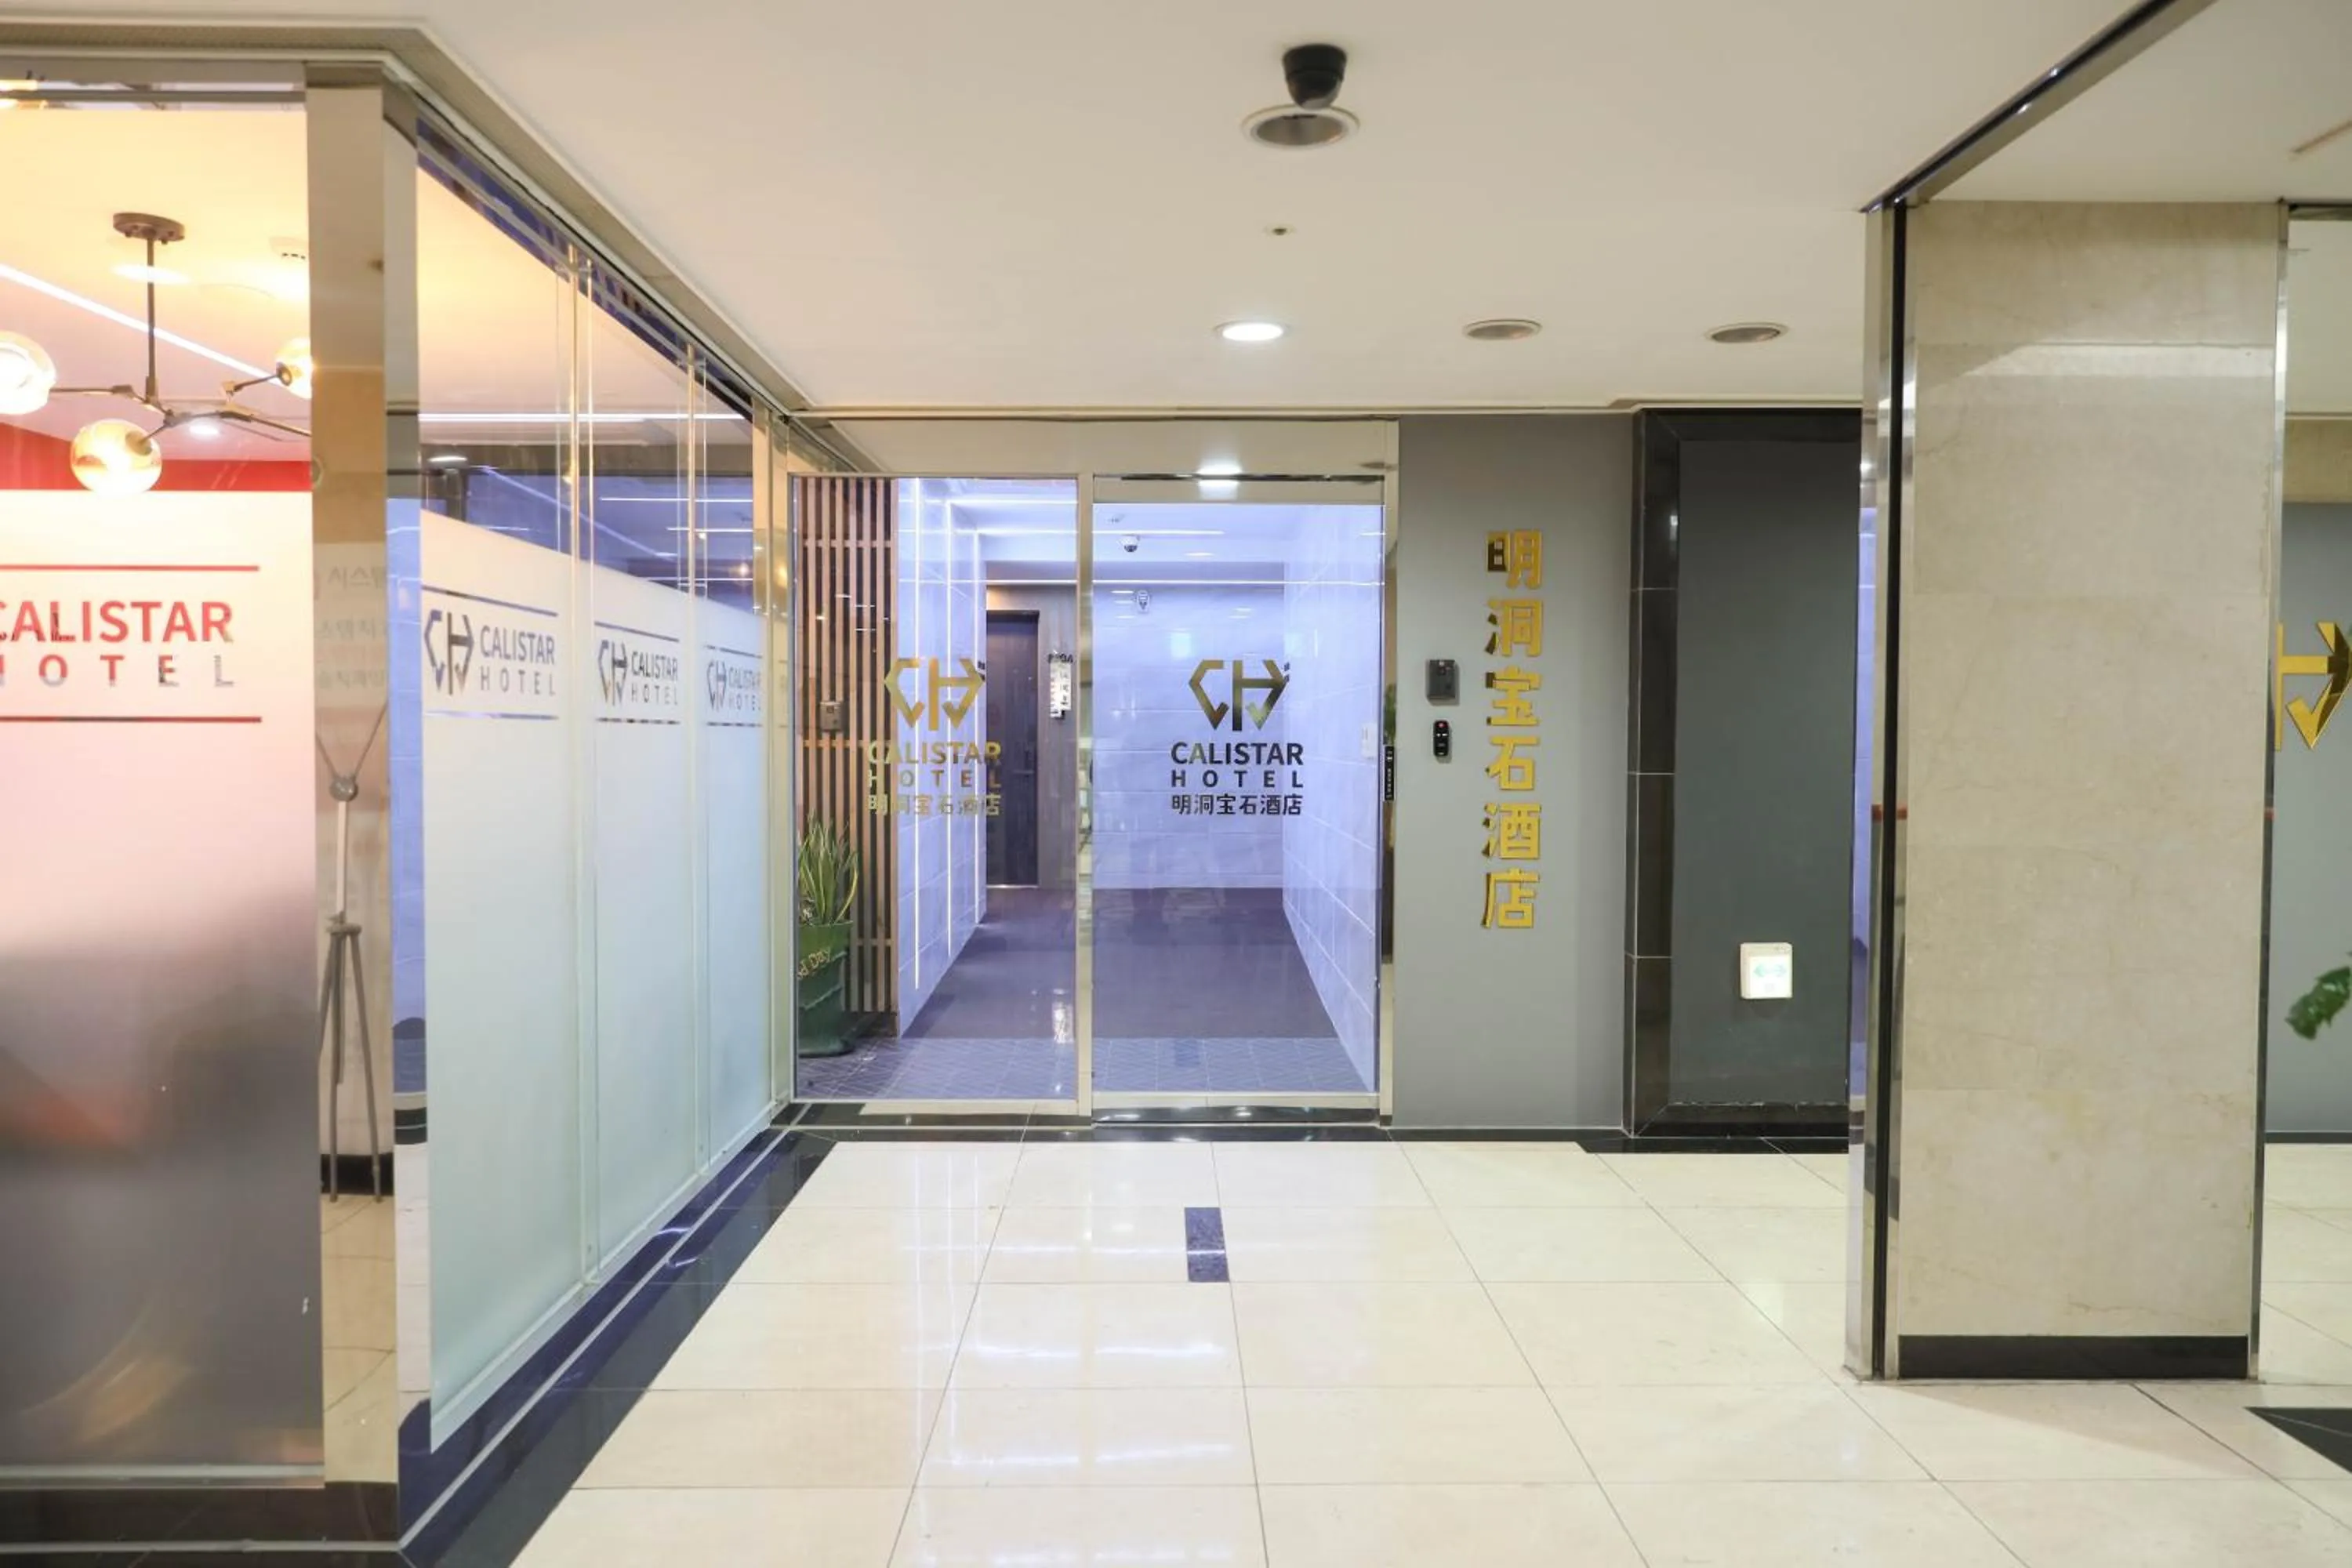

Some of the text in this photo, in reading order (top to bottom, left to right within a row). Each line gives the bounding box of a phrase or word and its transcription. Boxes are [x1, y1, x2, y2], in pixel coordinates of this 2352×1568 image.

[0, 601, 234, 643] ALISTAR
[480, 625, 555, 665] CALISTAR
[631, 652, 678, 681] CALISTAR
[480, 666, 556, 696] HOTEL
[631, 684, 678, 706] HOTEL
[1481, 528, 1542, 928] 明洞宝石酒店
[869, 741, 1001, 765] CALISTAR
[1171, 742, 1304, 765] CALISTAR
[869, 769, 1001, 788] HOTEL
[1171, 770, 1304, 788] HOTEL
[1171, 793, 1304, 815] 明洞宝石酒店
